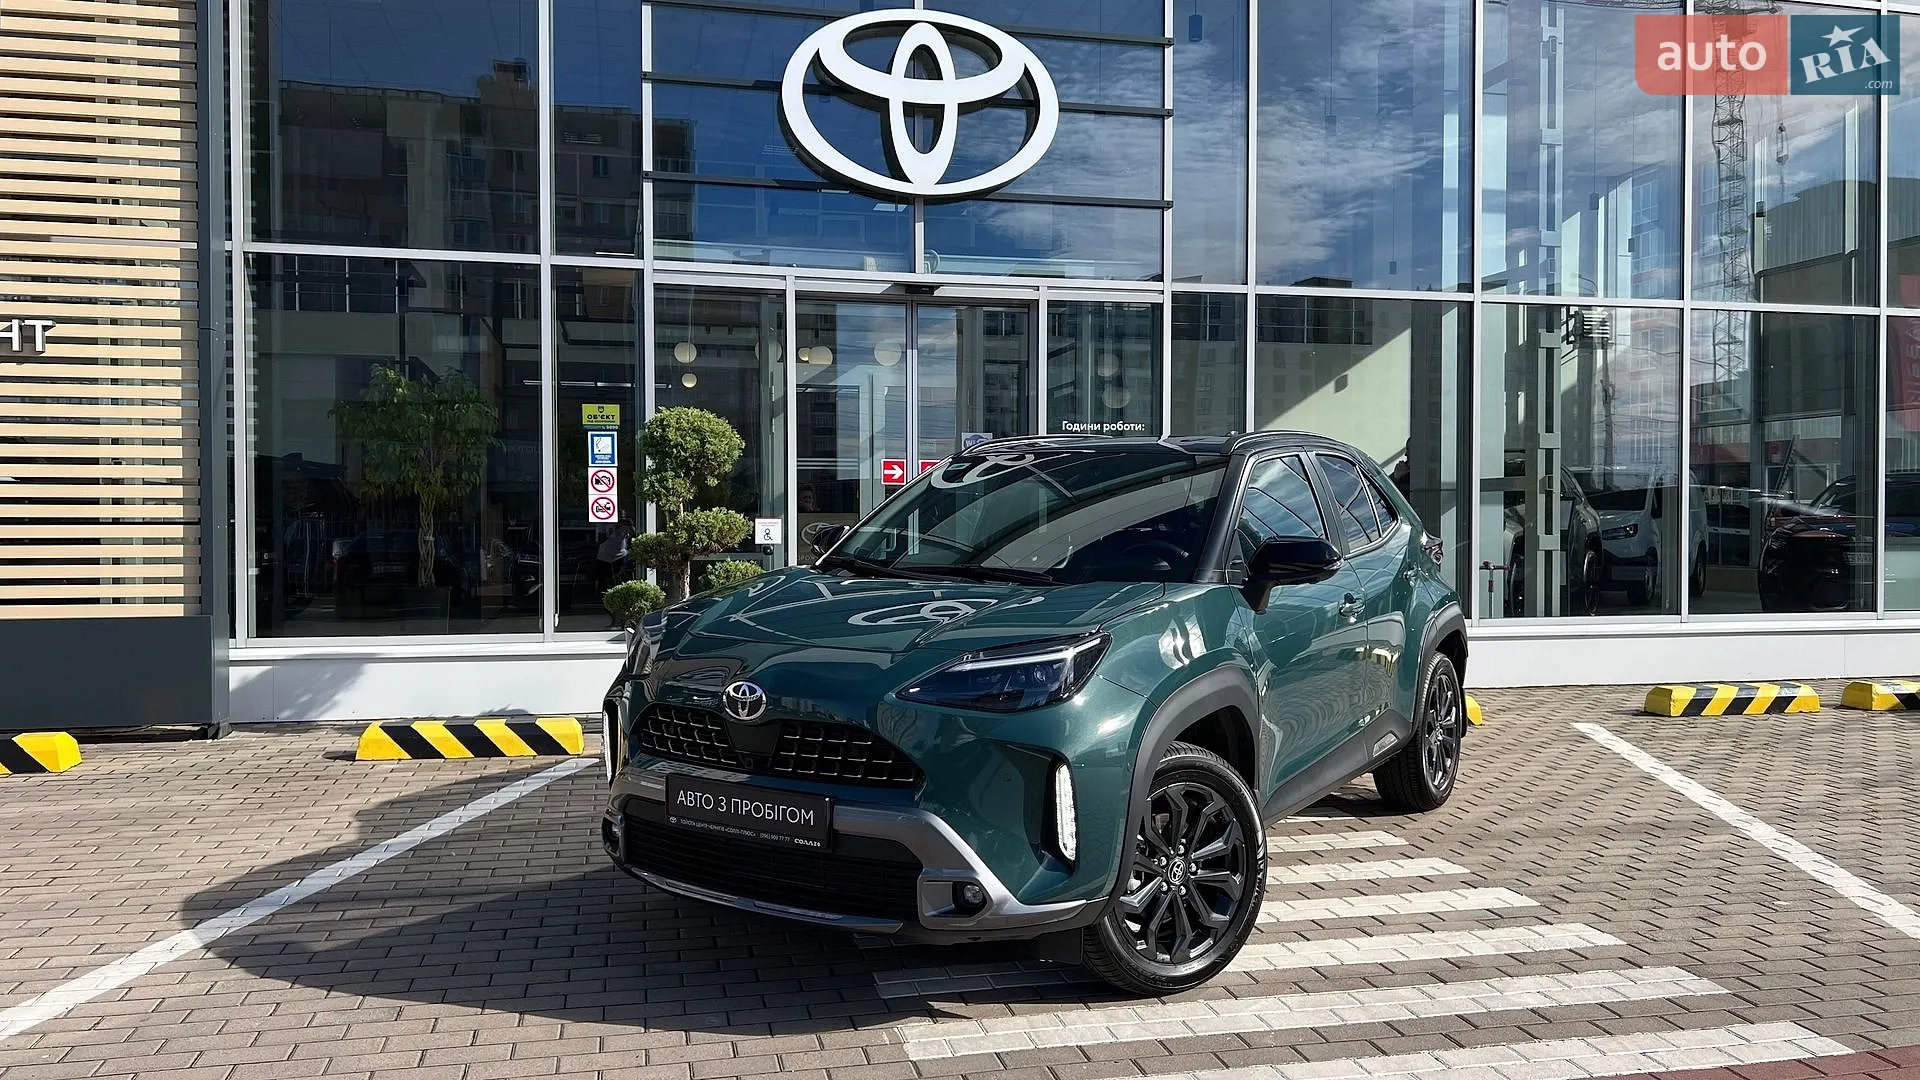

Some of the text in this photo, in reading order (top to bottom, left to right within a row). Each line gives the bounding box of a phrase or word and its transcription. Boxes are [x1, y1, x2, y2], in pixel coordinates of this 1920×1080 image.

[1062, 420, 1145, 433] Години роботи:
[676, 789, 714, 810] АВТО
[731, 798, 814, 826] ПРОБІГОМ
